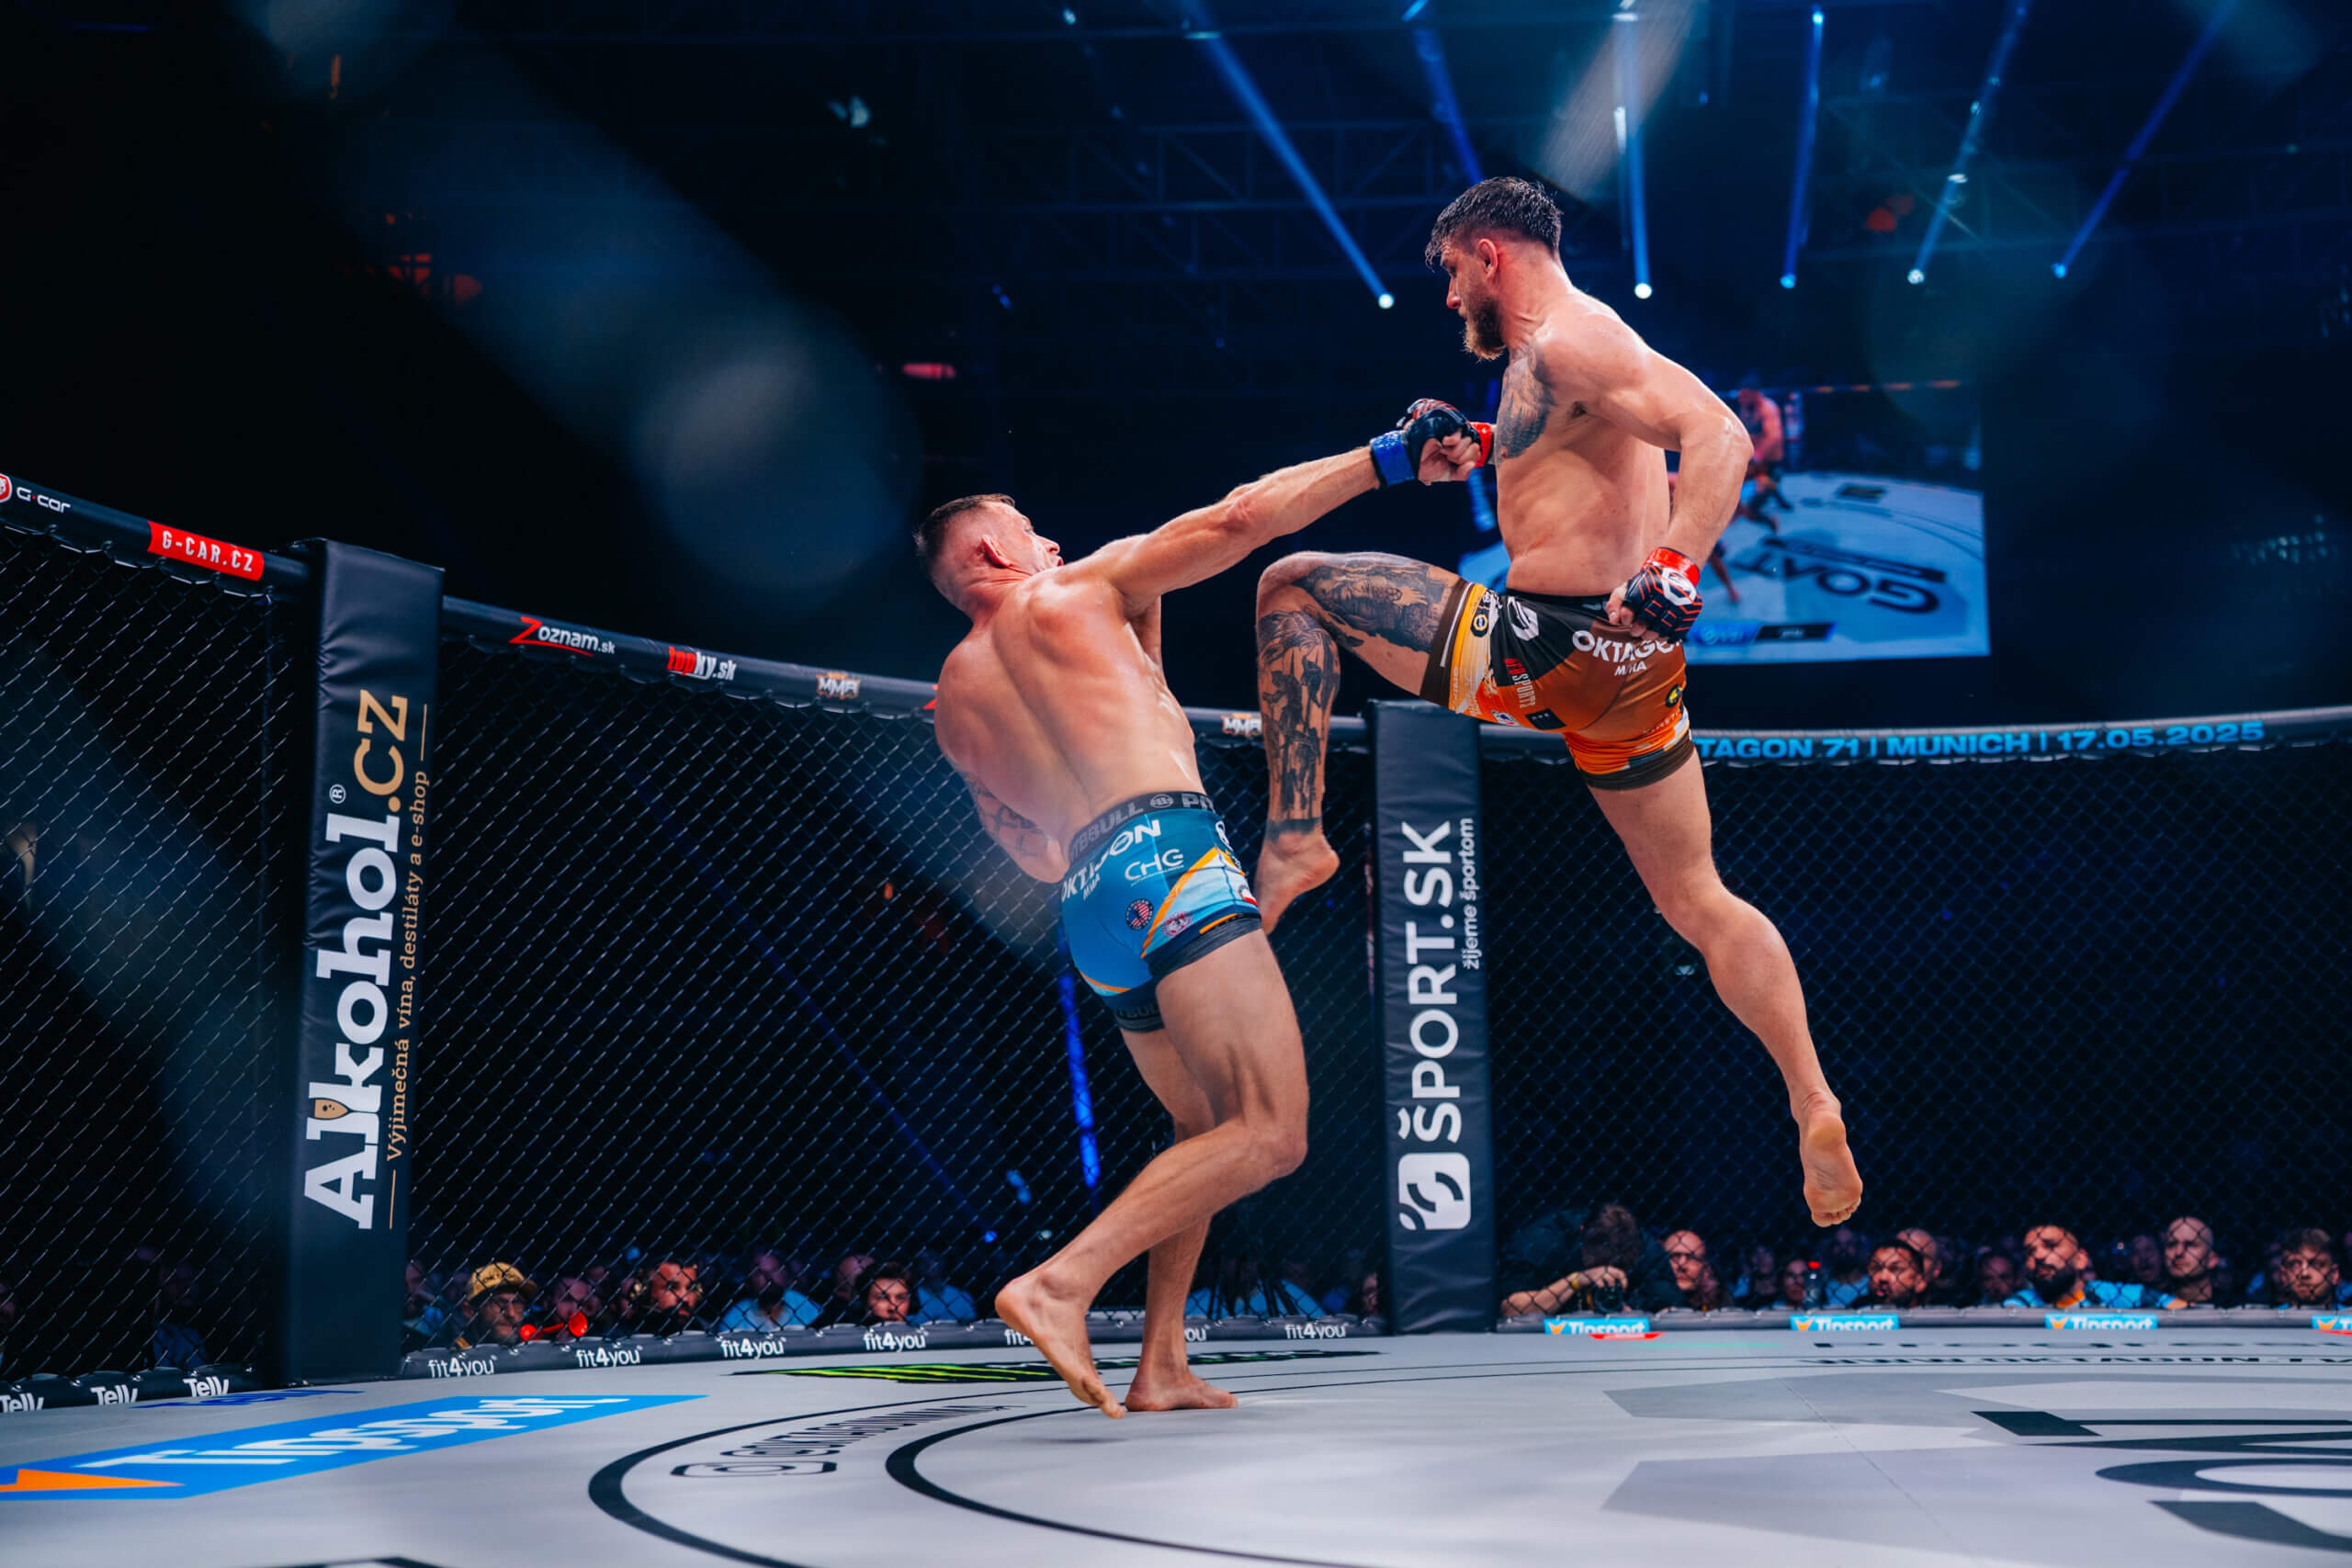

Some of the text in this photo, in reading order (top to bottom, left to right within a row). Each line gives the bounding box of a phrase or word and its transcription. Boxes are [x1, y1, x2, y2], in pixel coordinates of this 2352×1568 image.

[162, 530, 254, 573] G-CAR.CZ
[509, 616, 616, 657] Zoznam.sk
[1693, 738, 1812, 757] TAGON
[1822, 738, 1859, 757] 71
[1886, 732, 2030, 757] MUNICH
[2057, 720, 2265, 750] 17.05.2025
[1125, 848, 1184, 881] CHG
[1458, 818, 1482, 970] žijeme športom
[387, 771, 429, 1162] Výjimečná vína, destiláty a e-shop
[1397, 820, 1462, 1144] ŠPORT.SK
[720, 1336, 785, 1359] fit4you
[863, 1331, 927, 1352] fit4you
[1285, 1323, 1347, 1340] fit4you
[428, 1358, 494, 1378] fit4you
[576, 1347, 640, 1368] fit4you
[73, 1397, 631, 1469] Tipsport
